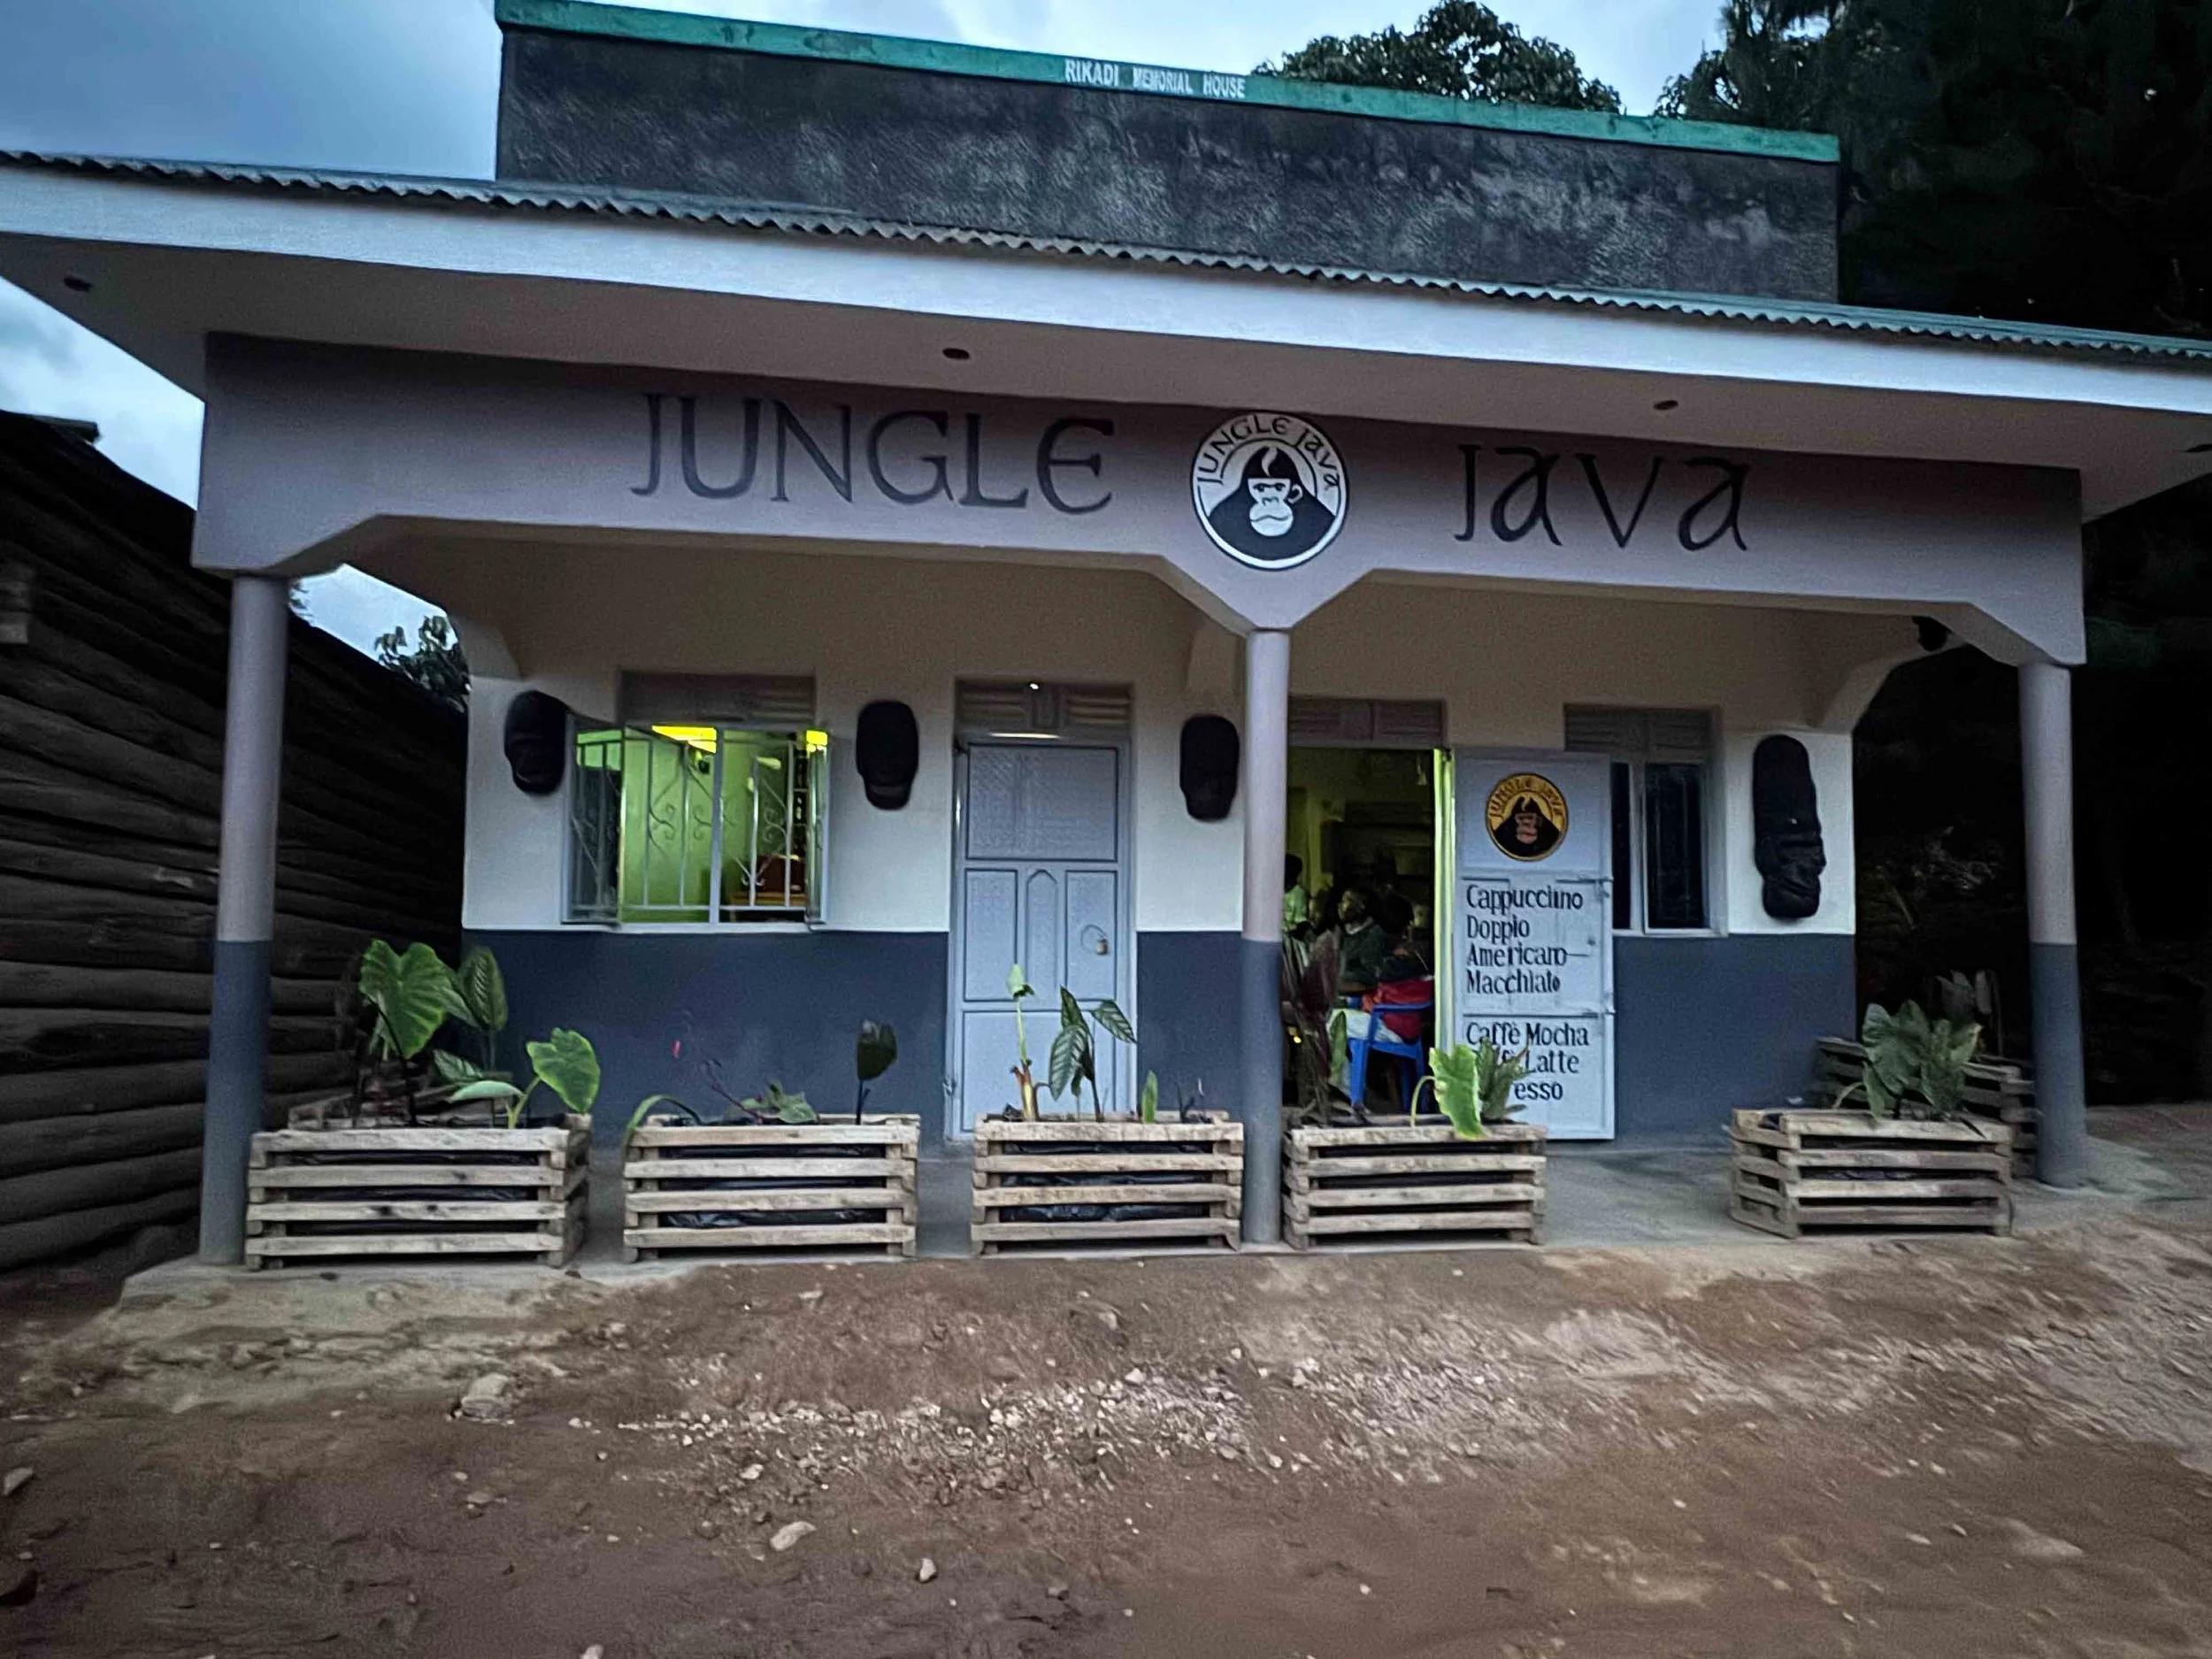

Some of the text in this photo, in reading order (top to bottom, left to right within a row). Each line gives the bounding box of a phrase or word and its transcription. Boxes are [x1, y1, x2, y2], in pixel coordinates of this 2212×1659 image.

[1064, 58, 1247, 99] RIKADI MEMORIAL HOUSE
[630, 392, 1115, 515] JUNGLE
[1197, 414, 1291, 486] JUNGLE
[1466, 914, 1531, 945] Doppio
[1466, 941, 1568, 967] Americano
[1466, 968, 1562, 995] Macchiato
[1525, 1022, 1590, 1047] Mocha
[1525, 1049, 1580, 1074] Latte
[1513, 1080, 1563, 1101] esso
